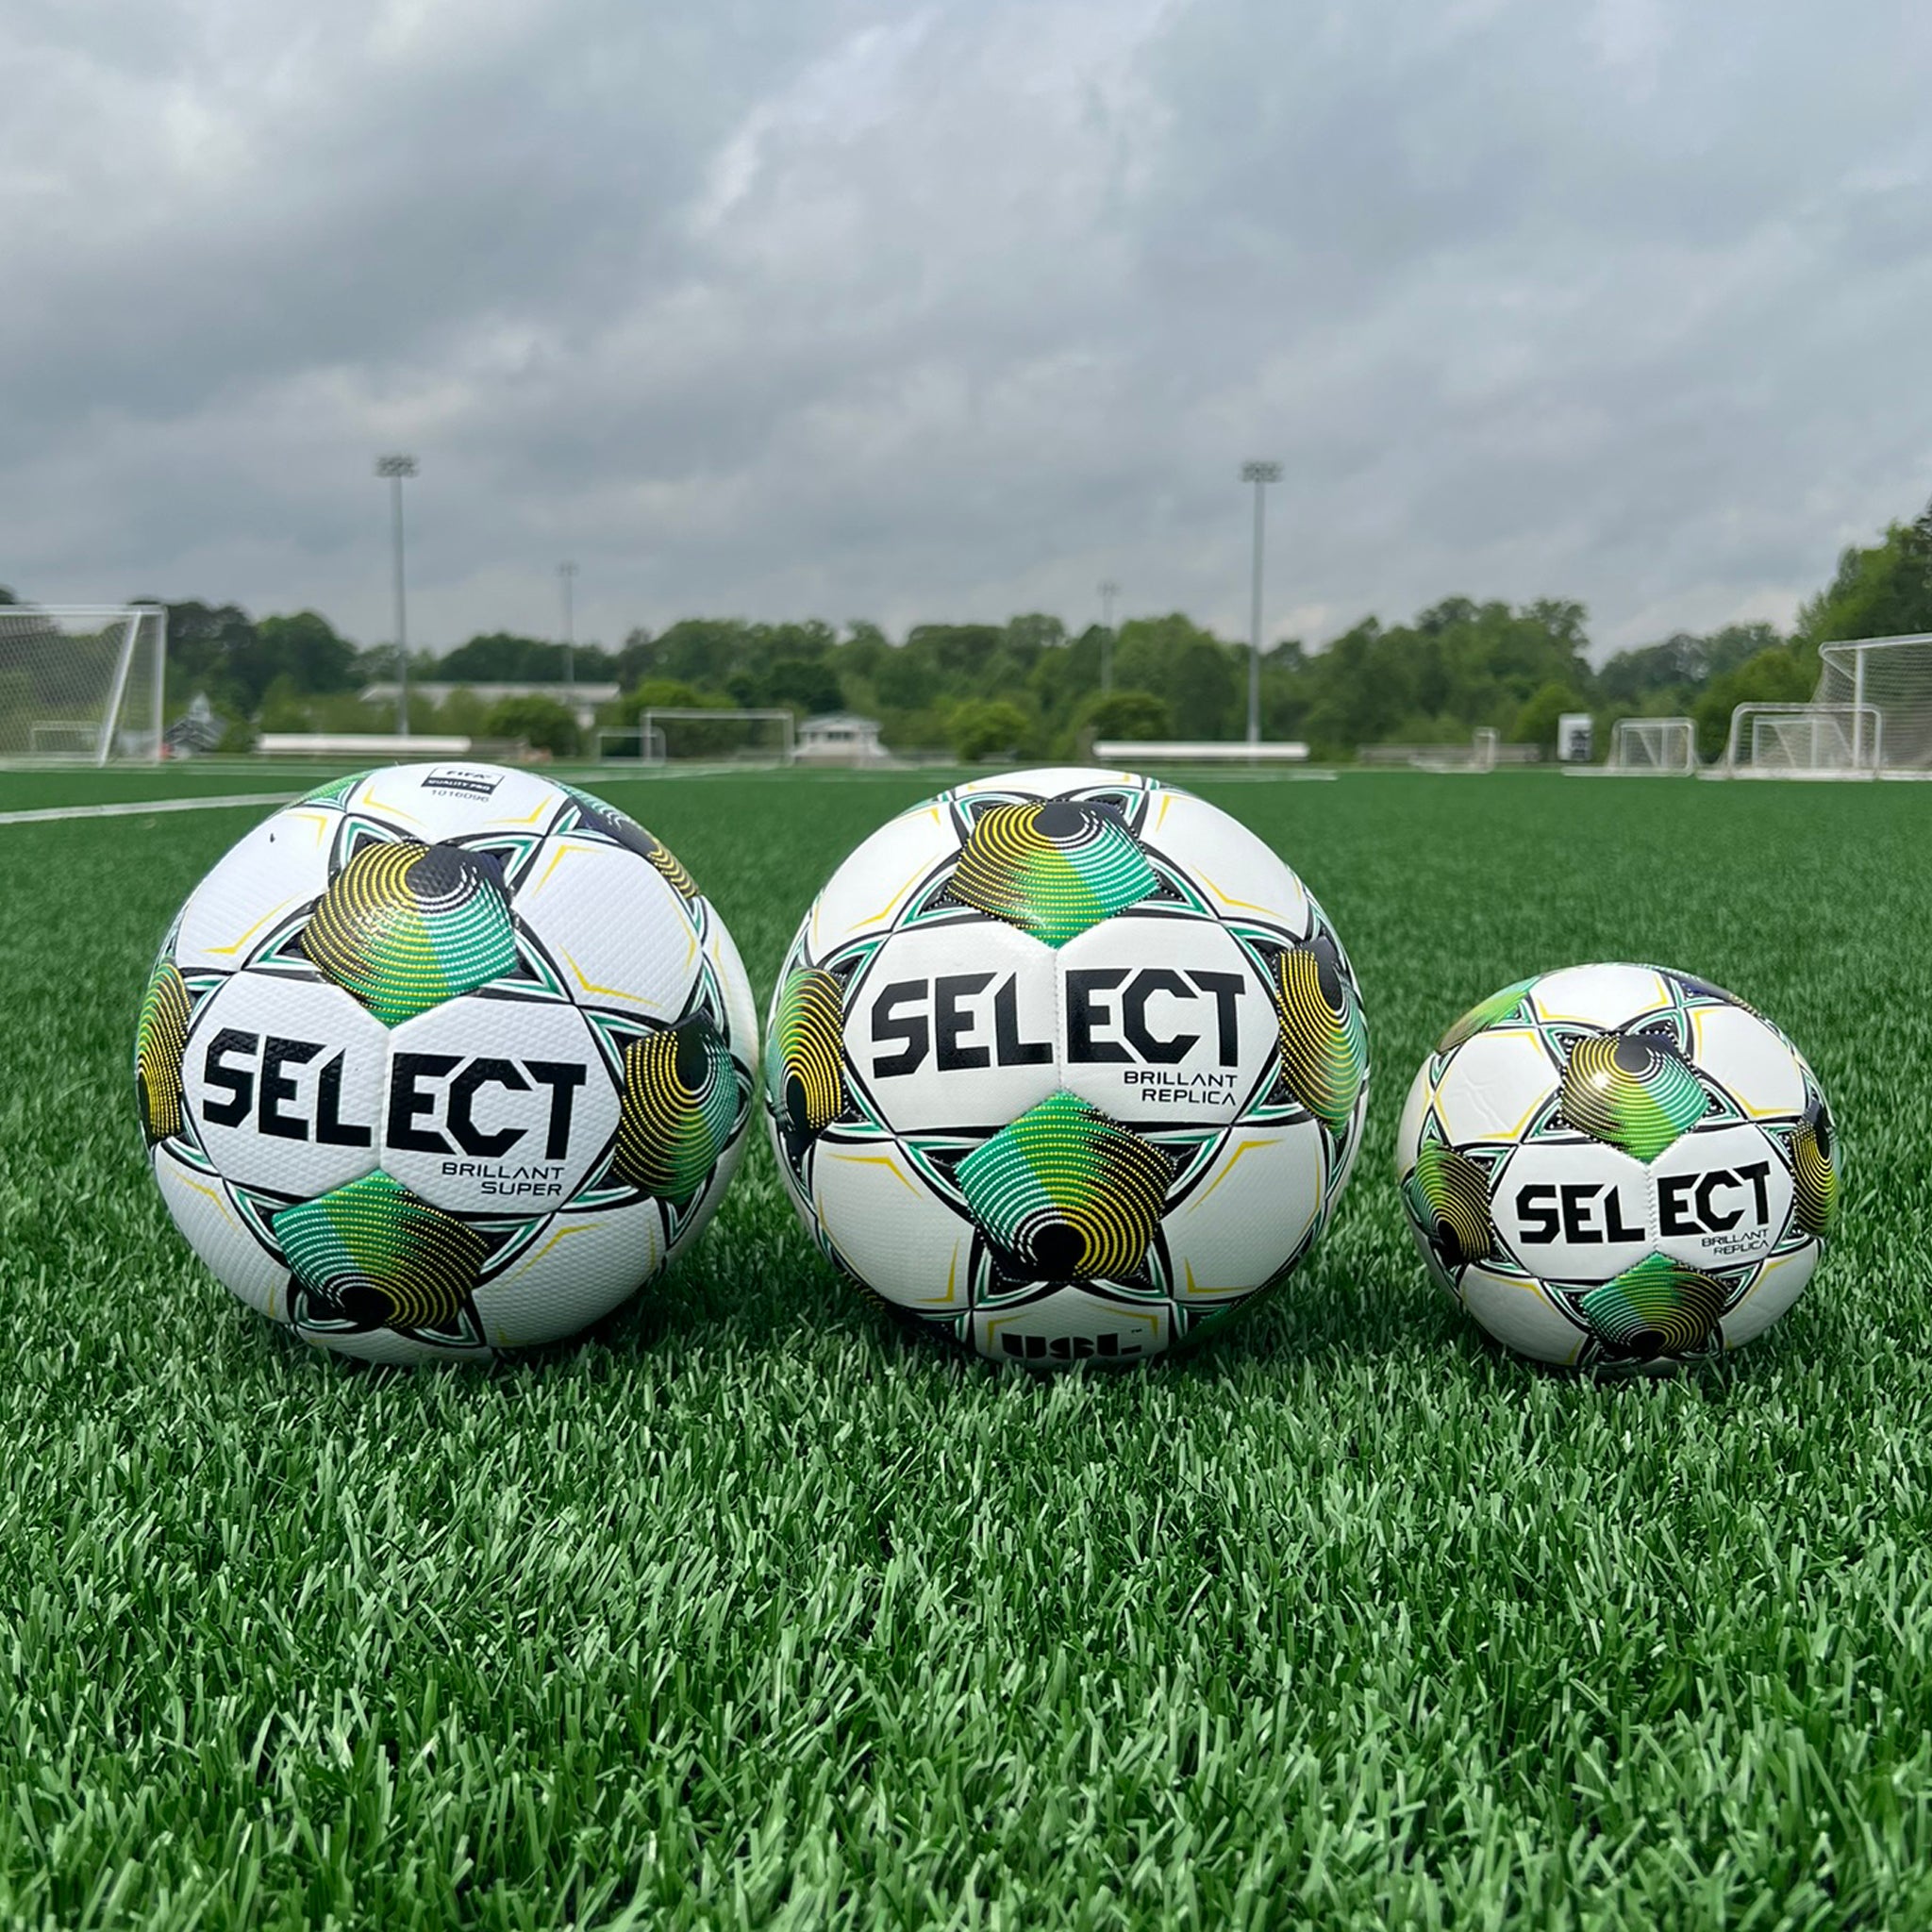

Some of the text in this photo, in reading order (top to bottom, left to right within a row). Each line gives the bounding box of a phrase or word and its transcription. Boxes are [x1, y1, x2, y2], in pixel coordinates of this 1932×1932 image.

[870, 969, 1246, 1079] SELECT
[1124, 1071, 1238, 1088] BRILLANT
[202, 1027, 586, 1159] SELECT
[1141, 1089, 1236, 1106] REPLICA
[441, 1161, 565, 1180] BRILLANT
[480, 1181, 562, 1196] SUPER
[1515, 1161, 1771, 1243] SELECT
[1701, 1228, 1769, 1247] BRILLANT
[1713, 1240, 1769, 1255] REPLICA
